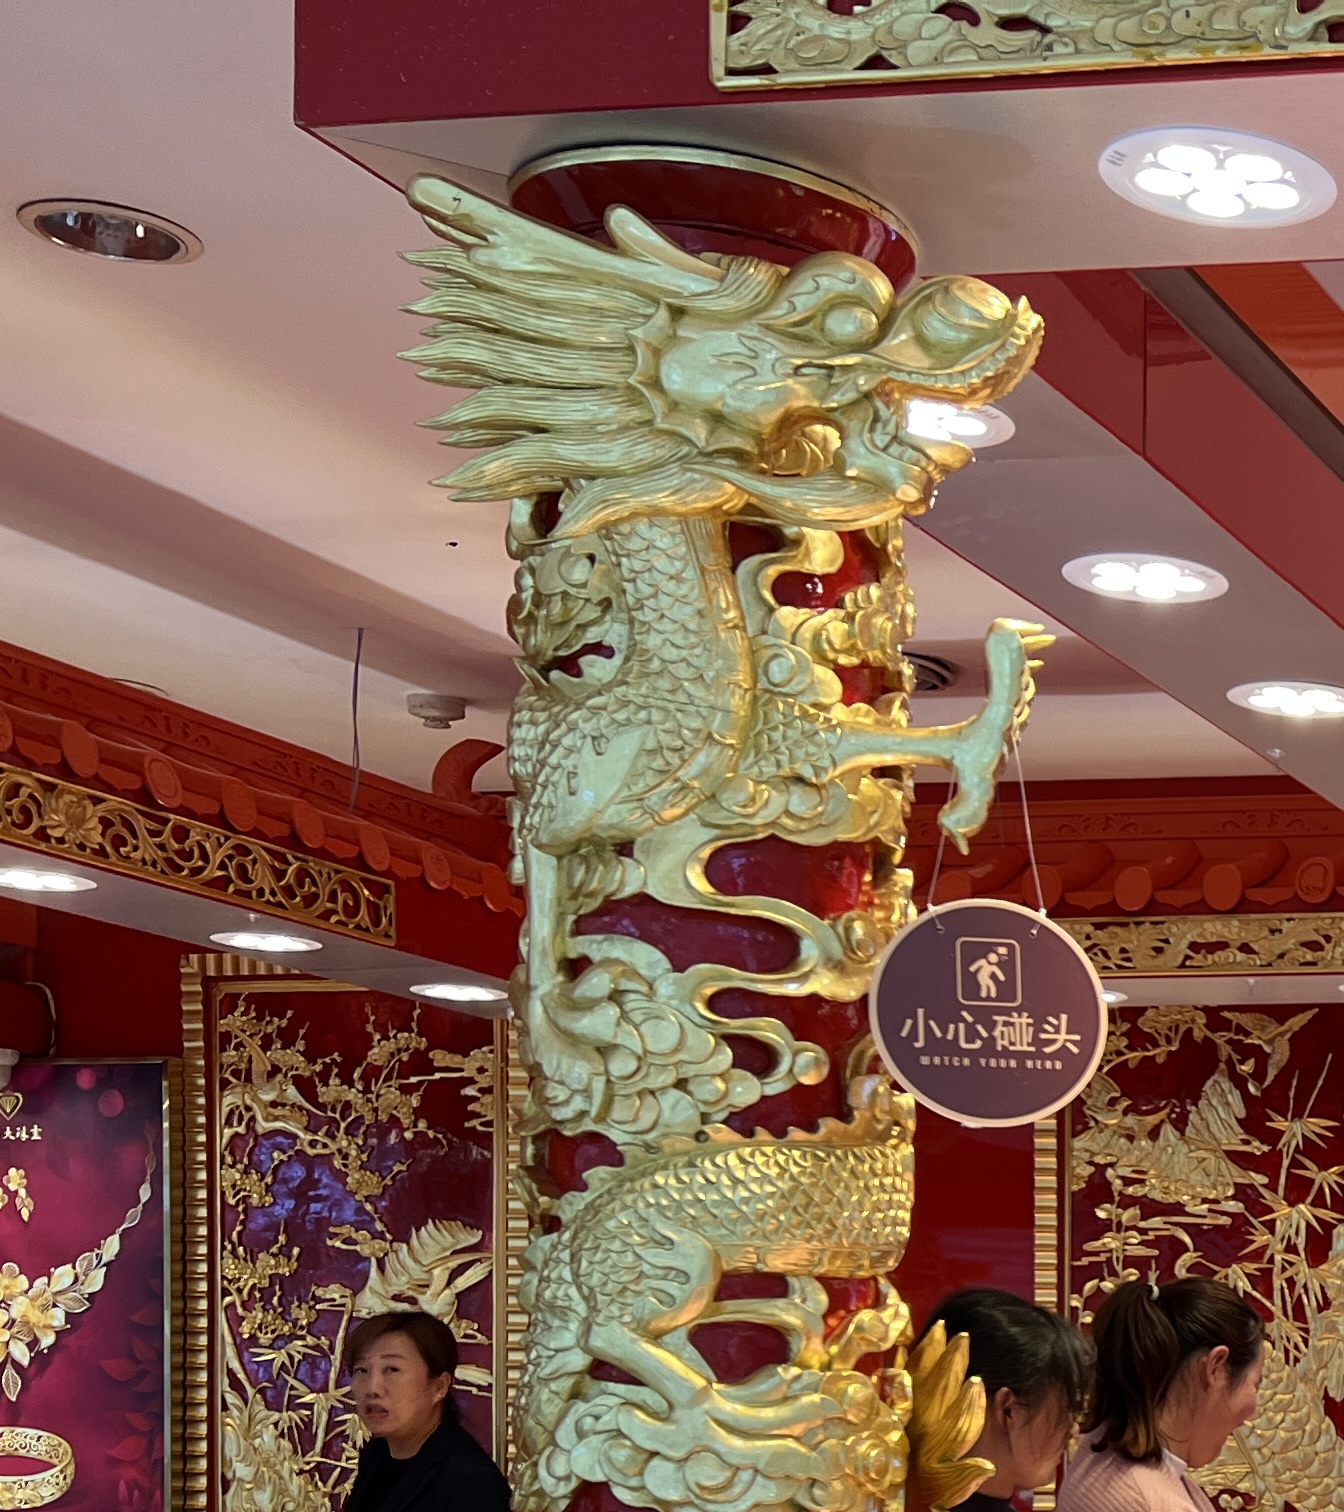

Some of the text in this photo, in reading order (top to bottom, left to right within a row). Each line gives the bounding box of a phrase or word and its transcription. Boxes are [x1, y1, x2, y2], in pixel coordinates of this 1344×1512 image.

[899, 1007, 1081, 1055] 小心碰头
[919, 1055, 1063, 1070] WATCH YOUR HEAD
